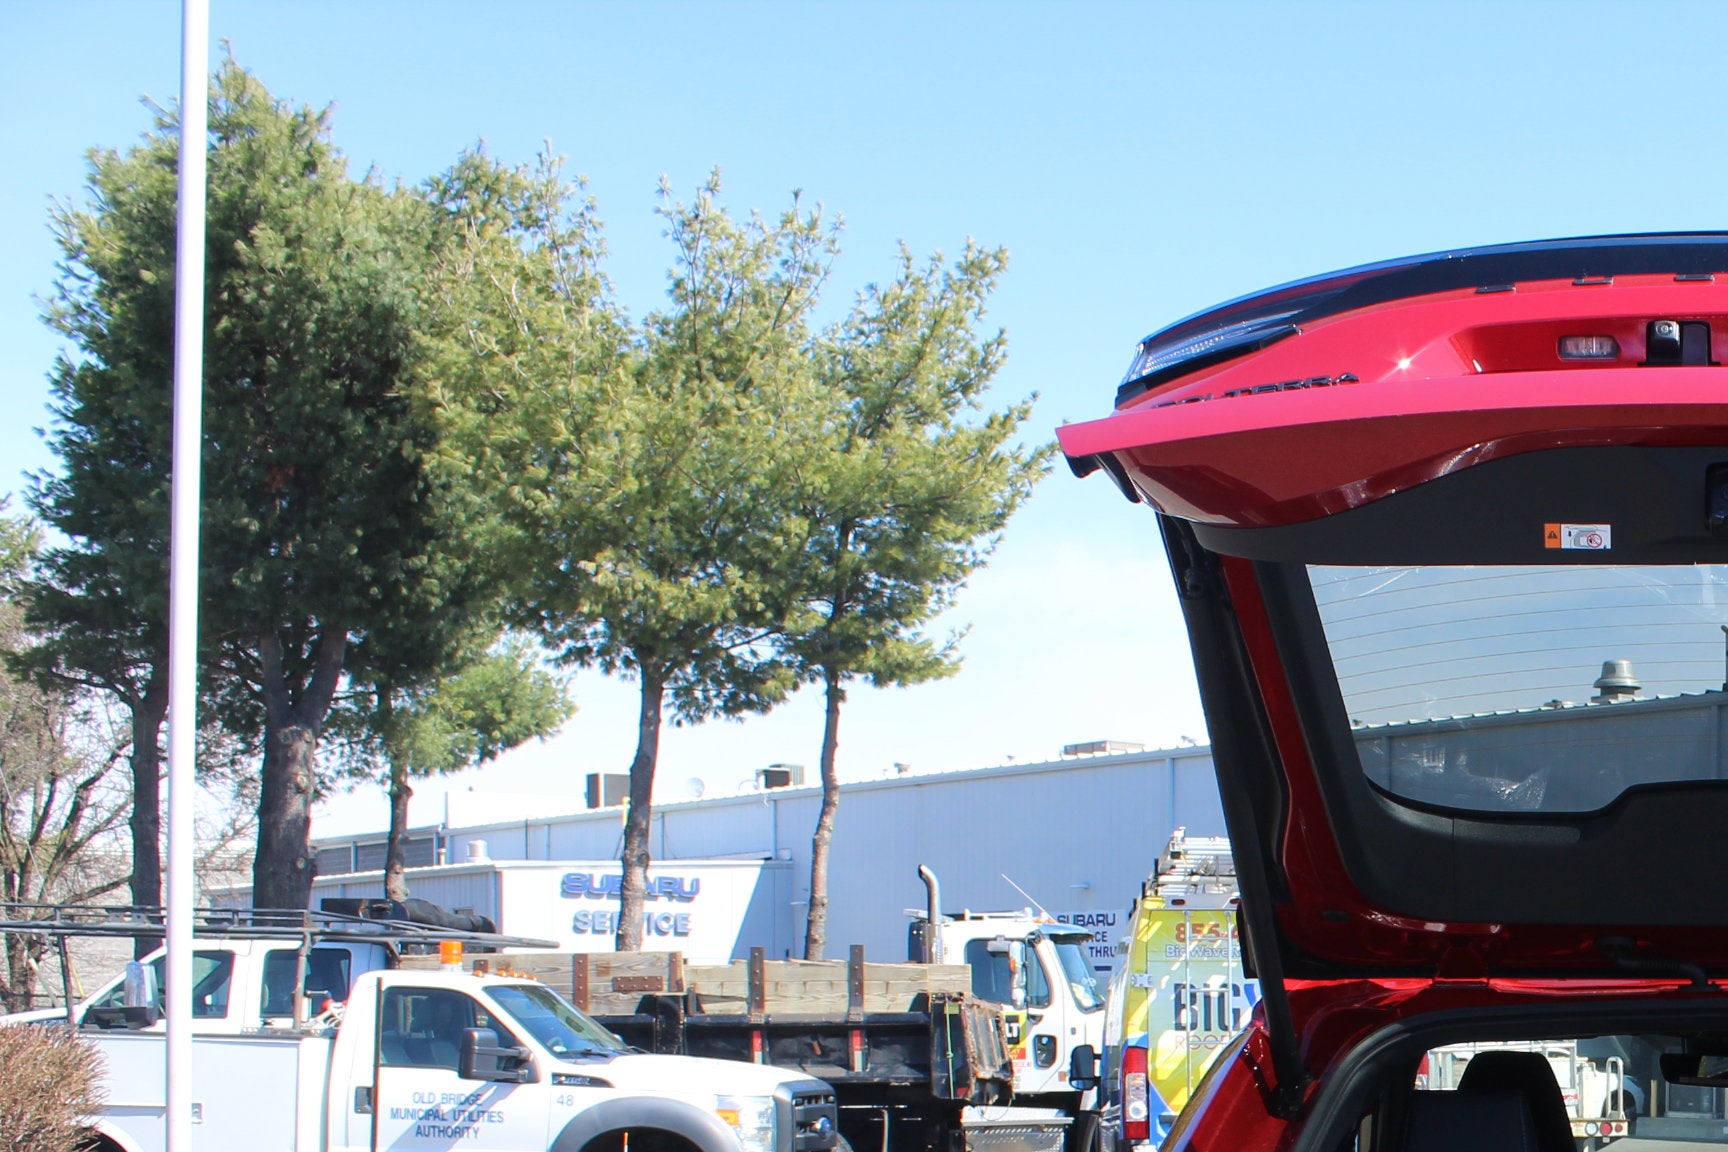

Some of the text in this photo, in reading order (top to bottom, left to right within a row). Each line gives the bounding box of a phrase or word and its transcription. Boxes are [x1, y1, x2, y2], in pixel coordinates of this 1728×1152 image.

[573, 909, 692, 935] SEICE
[1057, 913, 1116, 927] SUBARU
[1089, 946, 1117, 958] THRU
[1174, 983, 1241, 1031] BIG
[412, 1091, 483, 1106] OLD BRIDGE
[556, 1094, 574, 1107] 48
[390, 1107, 504, 1123] MUNICIPAL UTILITIES
[415, 1125, 480, 1139] AUTHORITY
